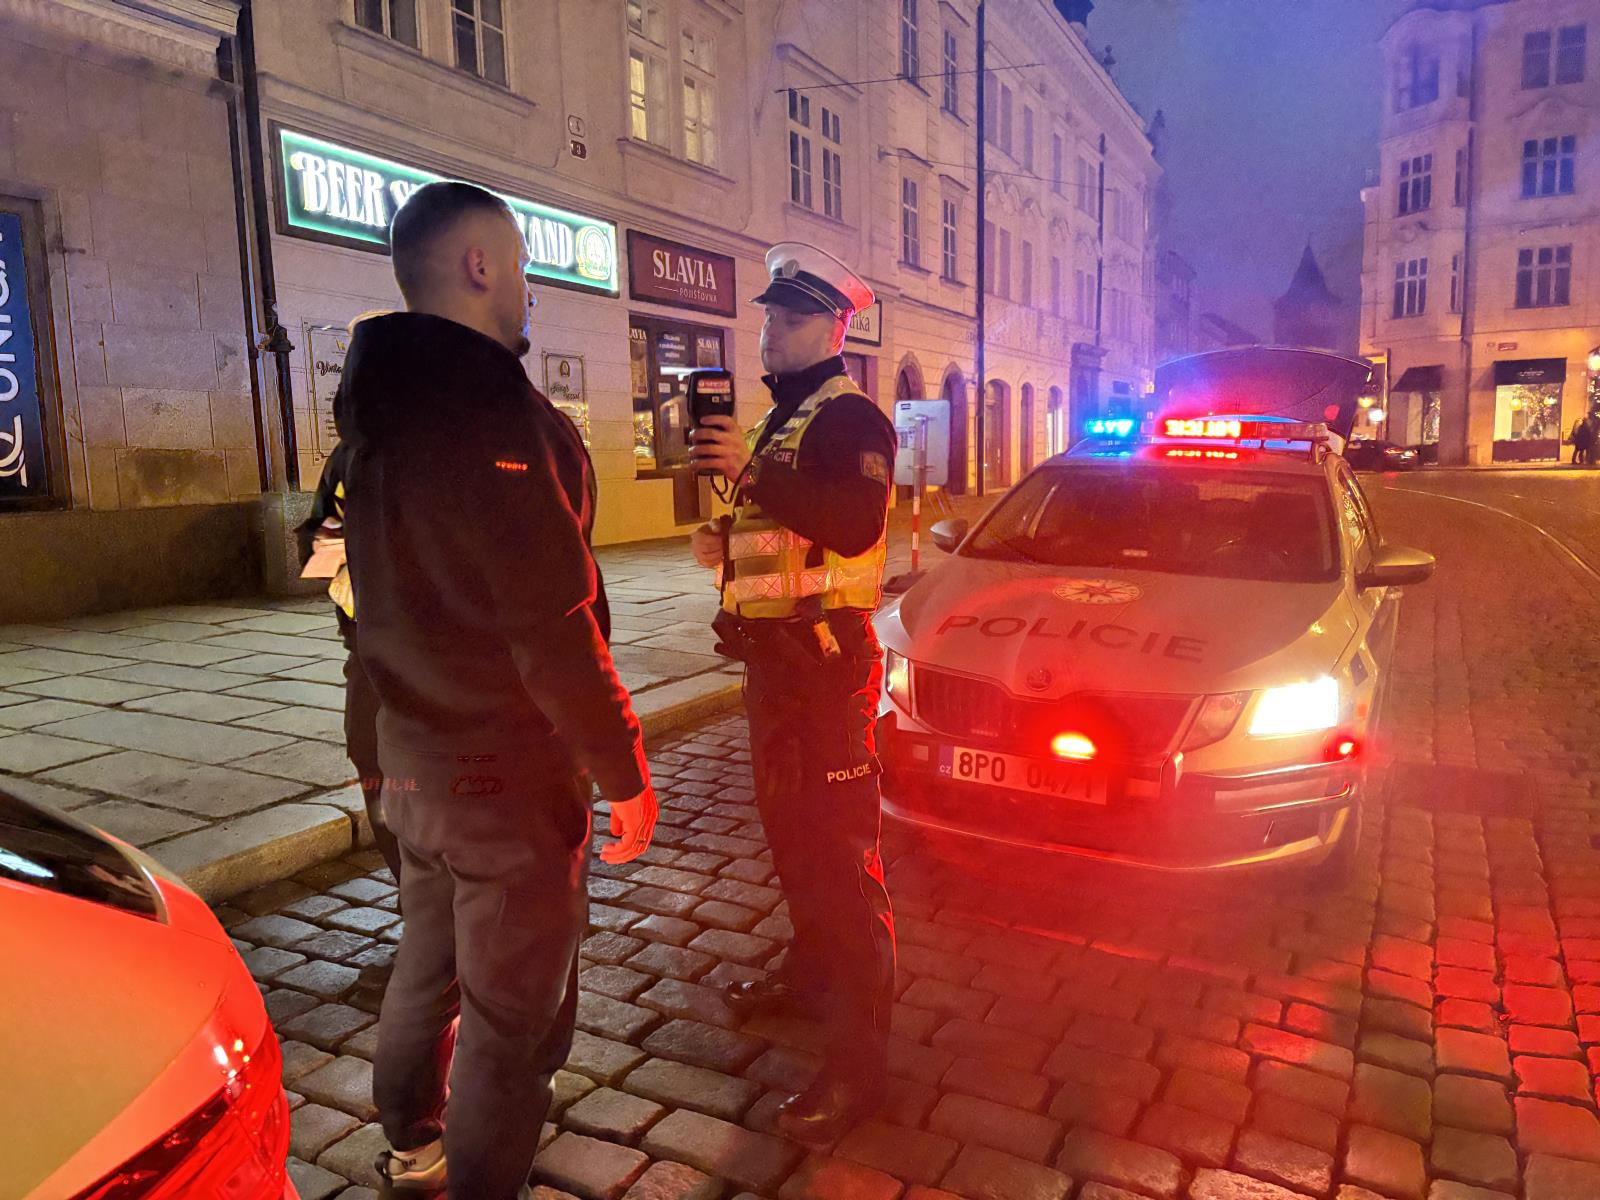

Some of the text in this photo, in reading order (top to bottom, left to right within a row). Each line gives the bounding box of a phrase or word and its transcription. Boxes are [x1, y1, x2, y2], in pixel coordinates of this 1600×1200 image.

[290, 151, 387, 227] BEER
[652, 249, 717, 290] SLAVIA
[935, 614, 1208, 664] POLICIE
[827, 763, 872, 783] POLICIE
[958, 751, 1006, 783] 8P0
